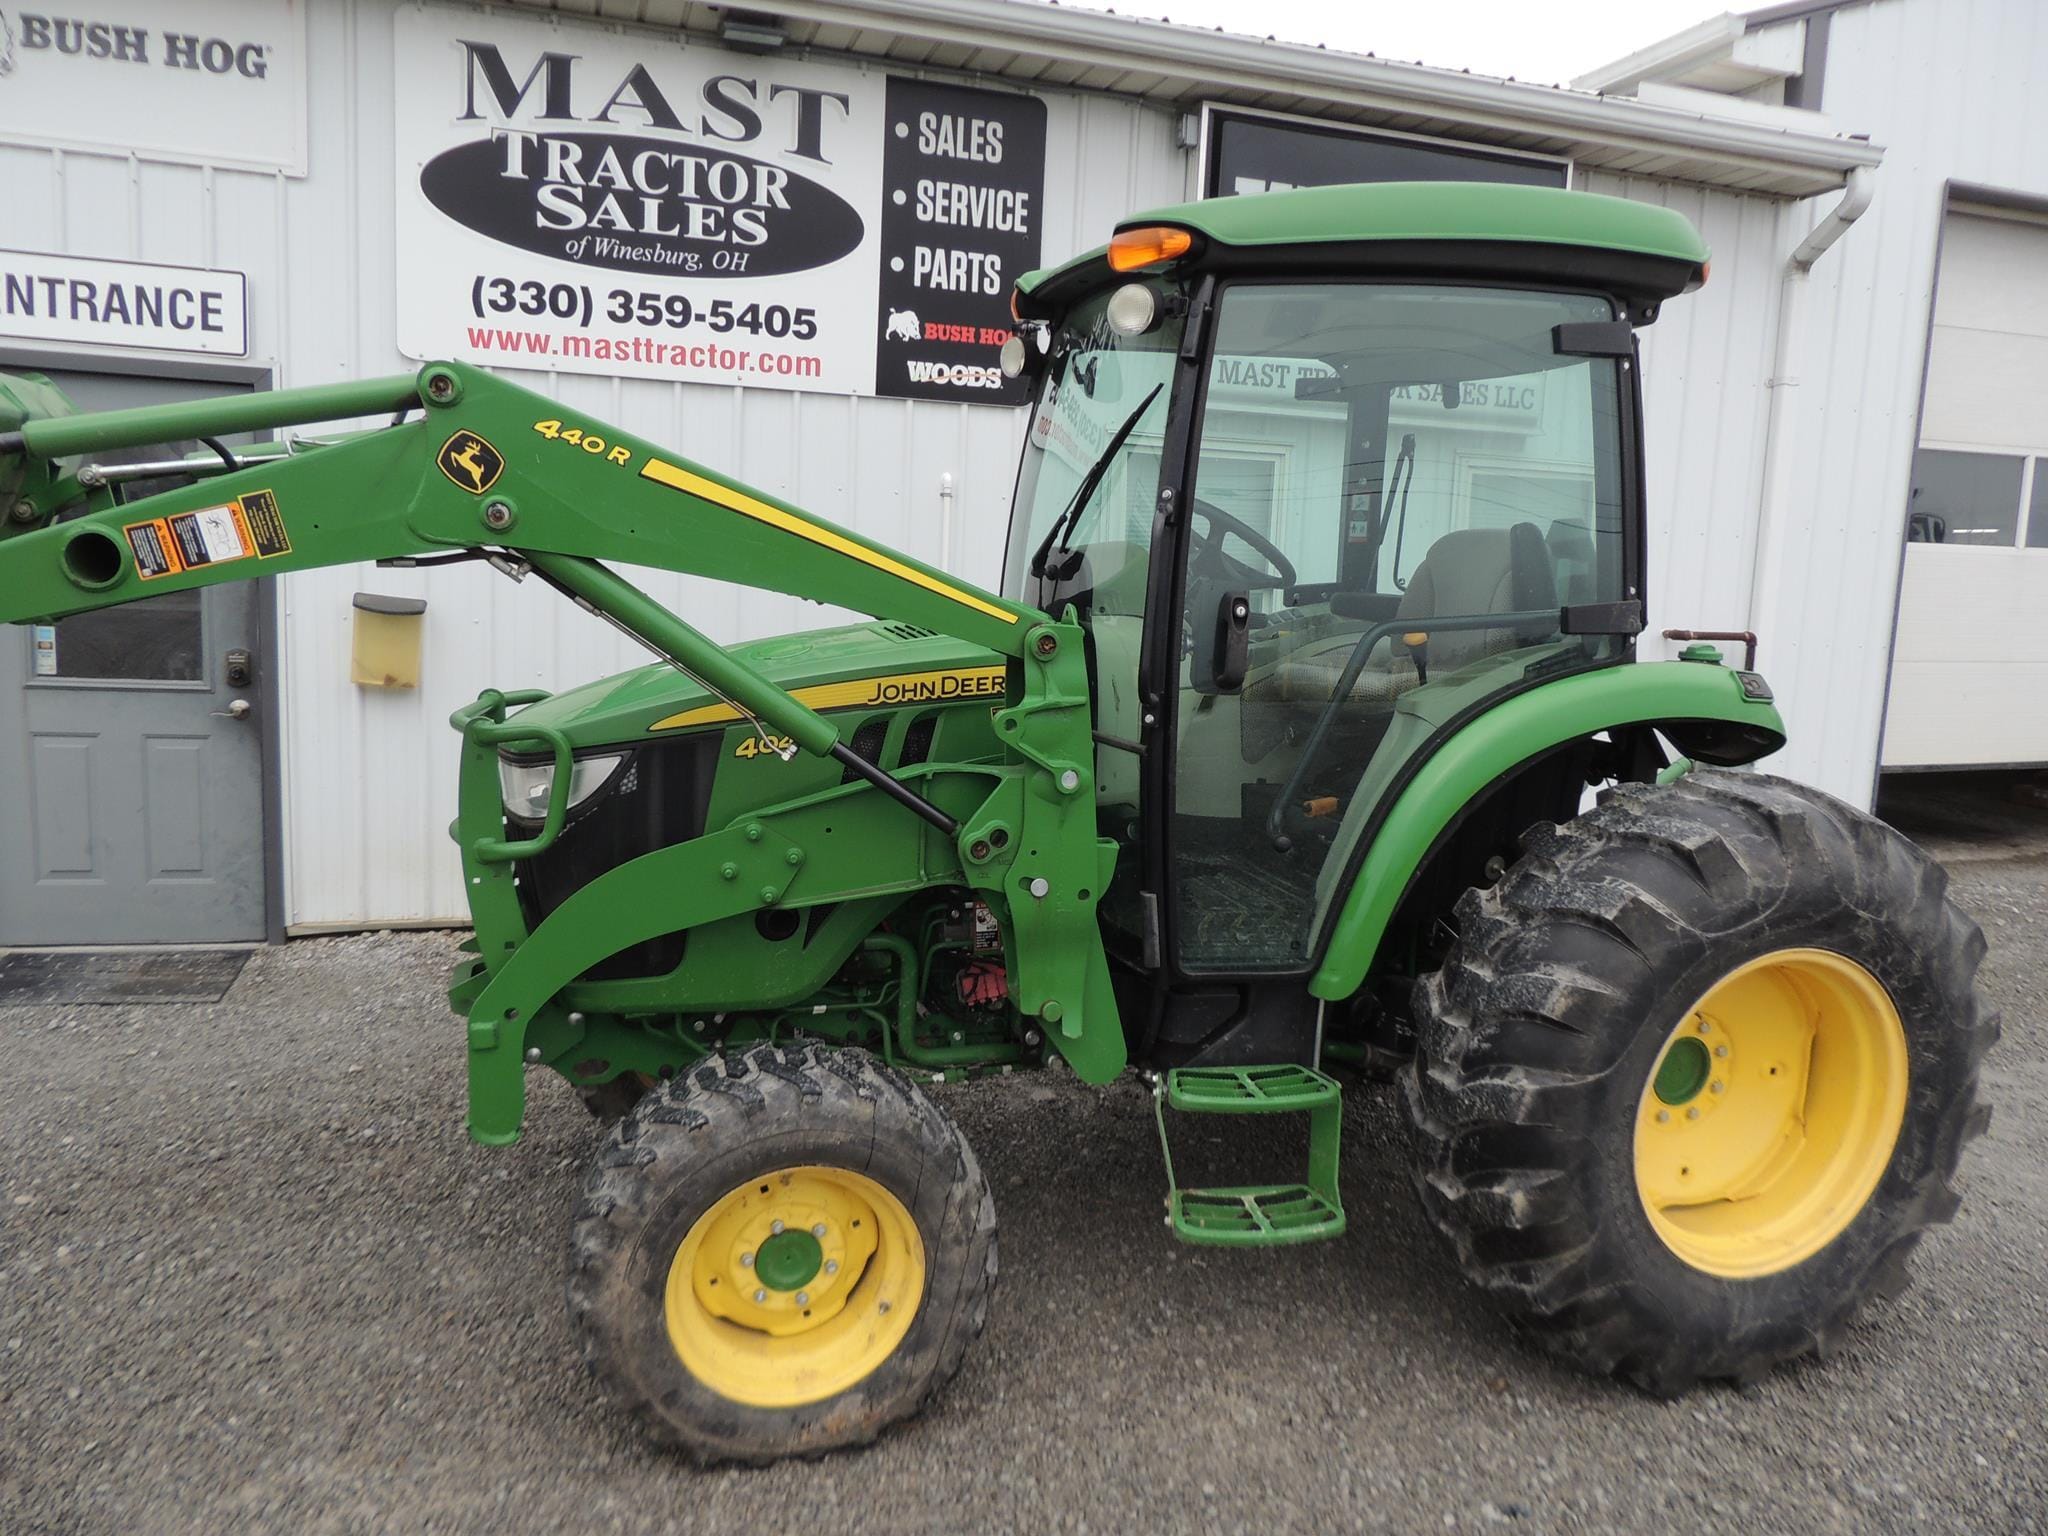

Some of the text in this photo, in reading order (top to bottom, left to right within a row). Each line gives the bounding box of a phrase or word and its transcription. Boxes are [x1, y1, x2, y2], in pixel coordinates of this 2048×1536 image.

[19, 12, 267, 80] BUSH HOG
[456, 39, 850, 165] MAST
[919, 111, 1003, 163] SALES
[491, 127, 791, 210] TRACTOR
[536, 184, 769, 246] SALES
[916, 179, 1029, 233] SERVICE
[565, 236, 750, 272] of Winesburg, OH
[914, 246, 1001, 295] PARTS
[0, 273, 224, 333] NTRANCE
[471, 276, 818, 340] (330) 359-5405
[468, 328, 822, 377] www.masttractor.com
[924, 323, 976, 343] BUSH
[907, 360, 1002, 389] WOODS
[1217, 360, 1291, 389] MAST
[1418, 382, 1488, 406] SAES
[1494, 387, 1535, 410] LLC
[867, 682, 937, 705] JOHN
